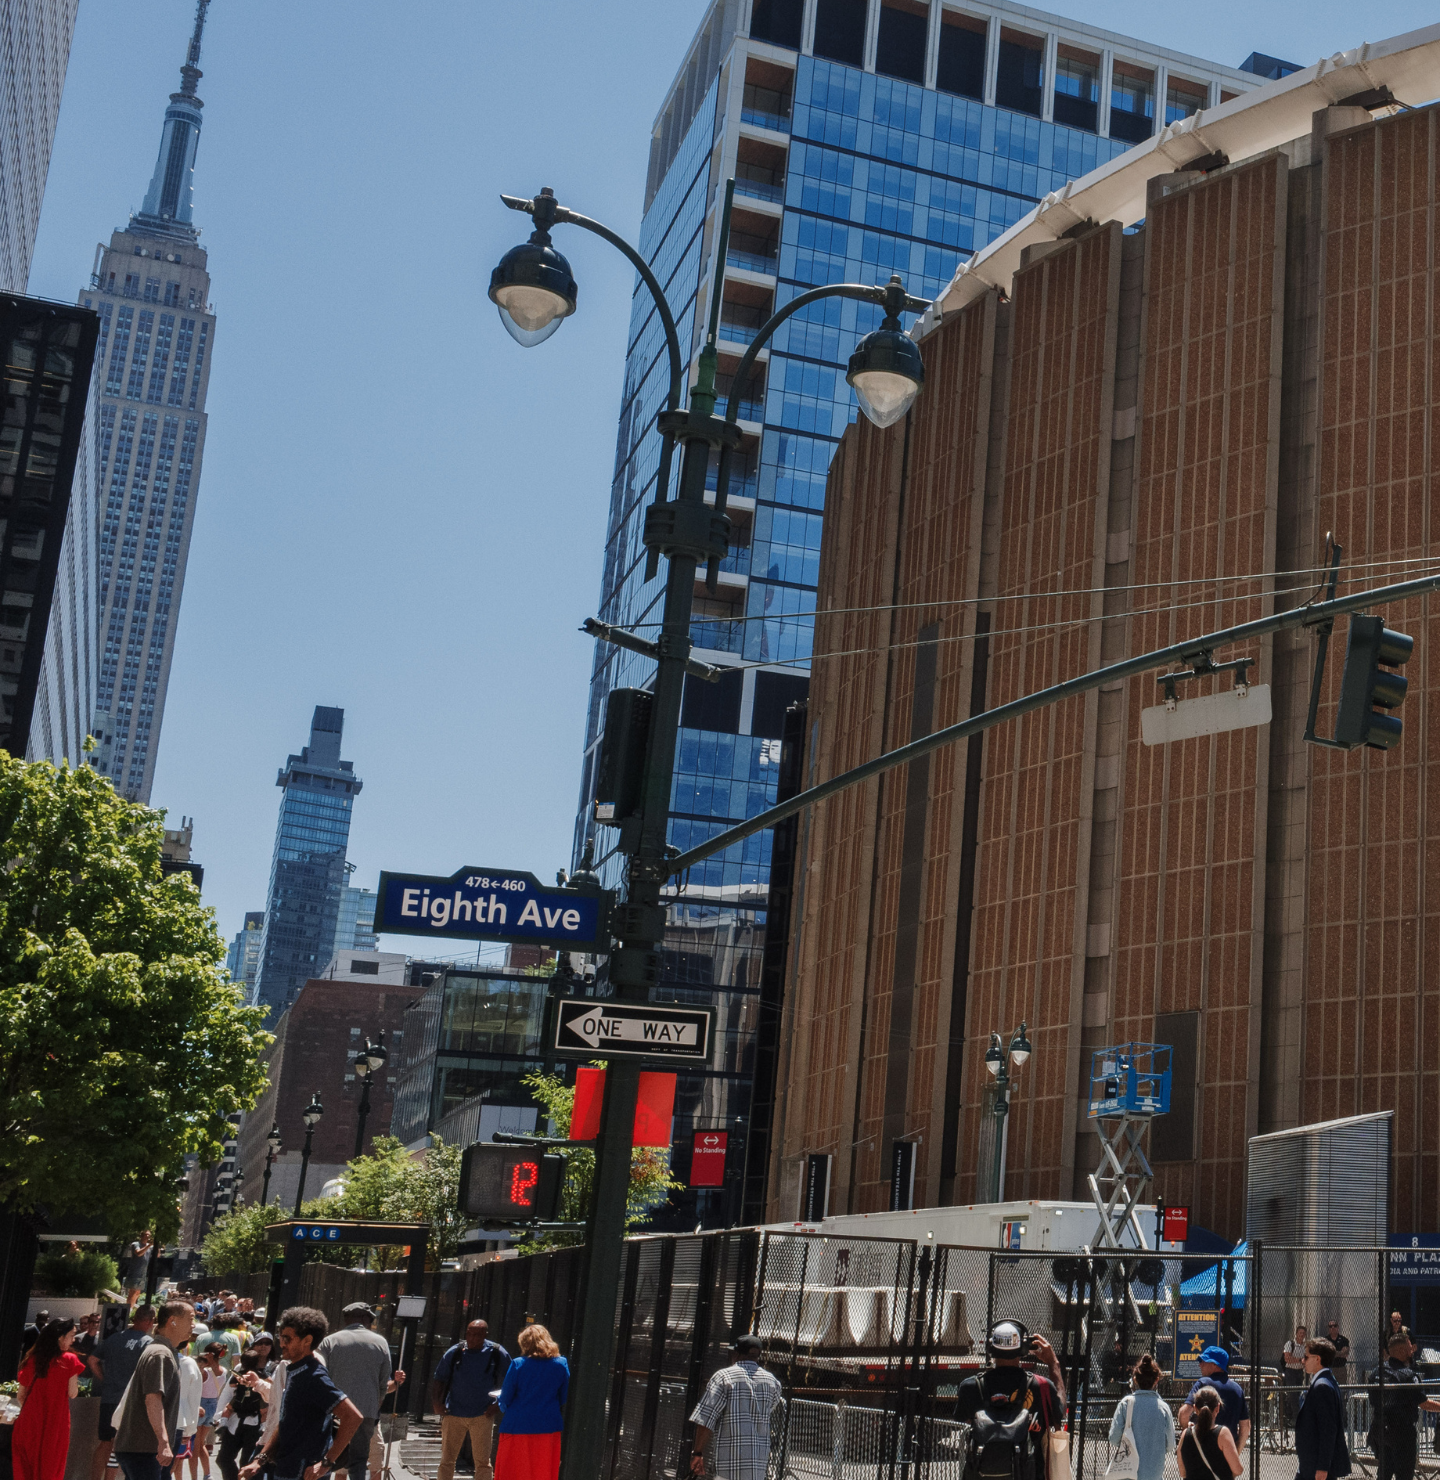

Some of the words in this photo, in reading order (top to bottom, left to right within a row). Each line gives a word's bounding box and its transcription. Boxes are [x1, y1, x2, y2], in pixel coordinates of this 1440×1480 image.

[465, 876, 489, 888] 478
[501, 880, 526, 891] 460
[401, 888, 507, 927] Eighth
[517, 899, 581, 930] Ave
[583, 1018, 622, 1037] ONE
[643, 1023, 686, 1042] WAY
[296, 1229, 304, 1237] A
[312, 1229, 320, 1238] C
[329, 1230, 337, 1238] E
[1411, 1237, 1419, 1247] 8
[1402, 1267, 1418, 1275] AND
